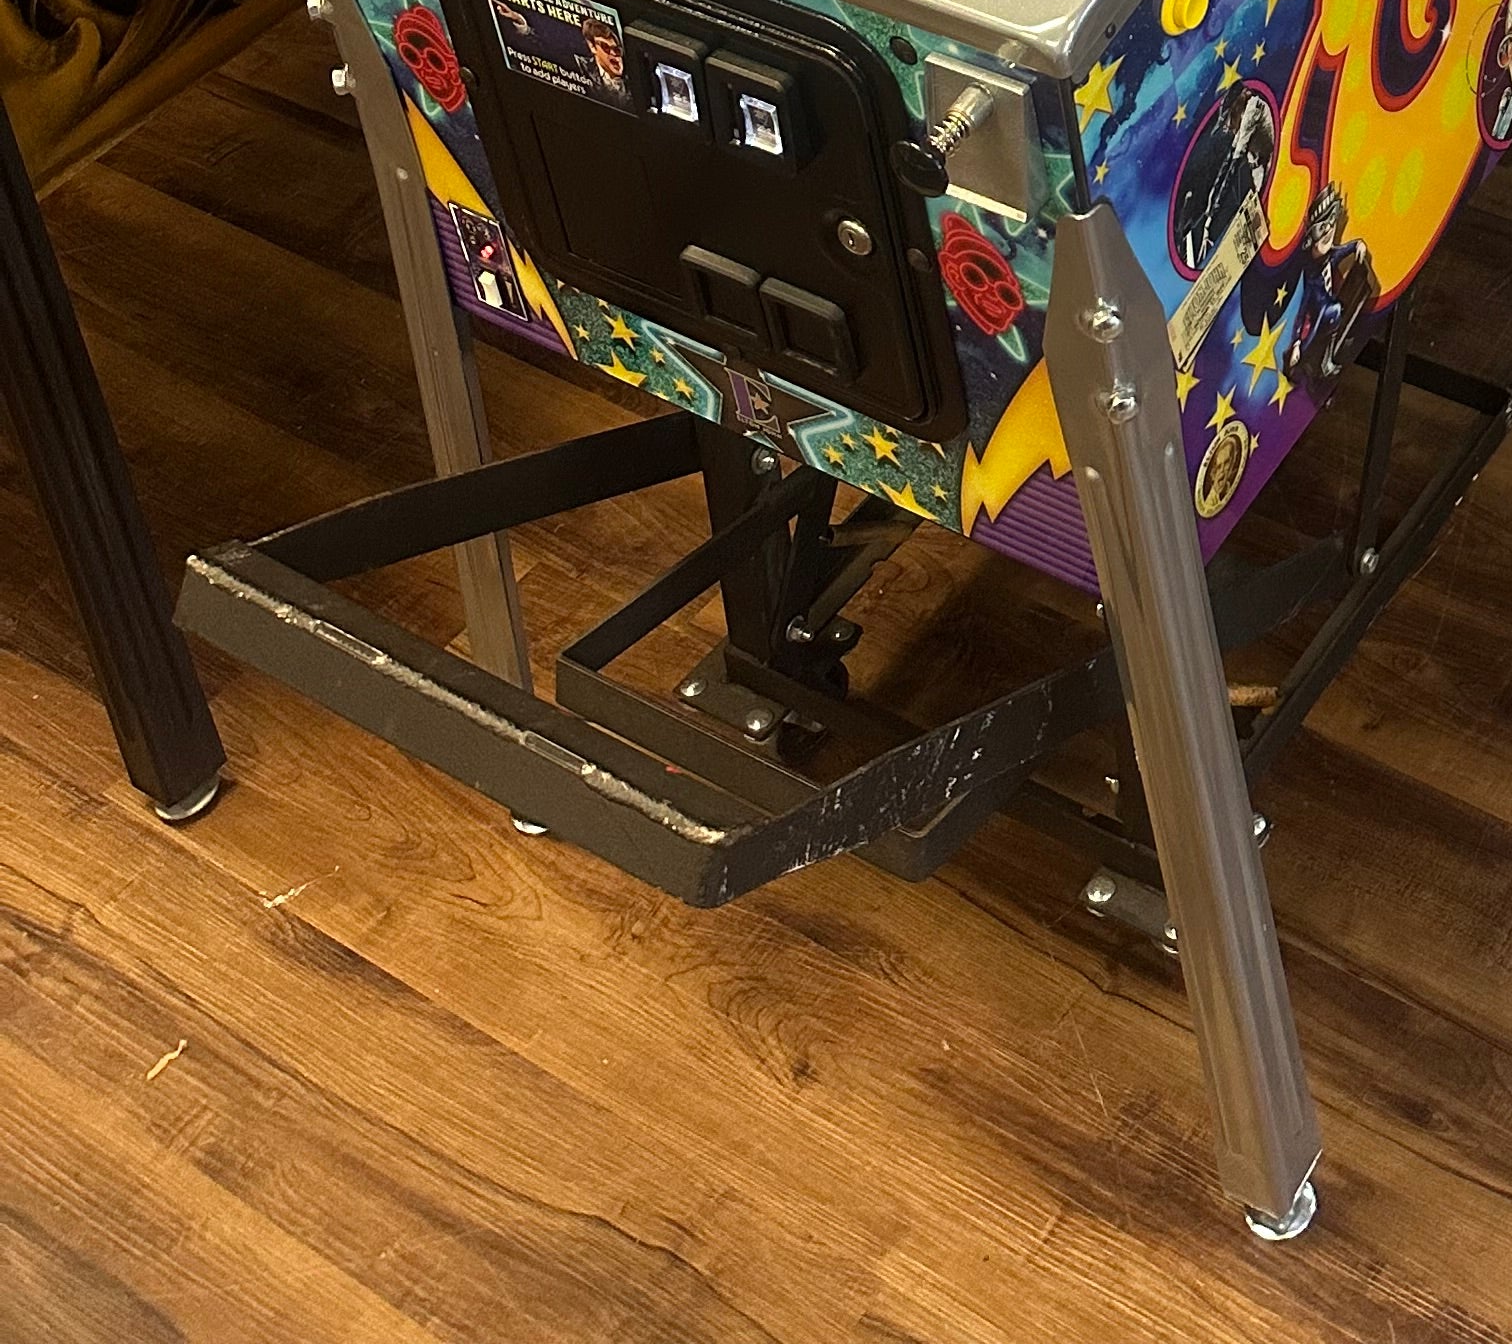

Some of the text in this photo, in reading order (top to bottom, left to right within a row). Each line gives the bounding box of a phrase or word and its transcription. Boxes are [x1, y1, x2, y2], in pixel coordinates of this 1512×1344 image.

[548, 5, 582, 26] HERE
[507, 47, 594, 87] Press START button
[520, 62, 586, 94] to add players
